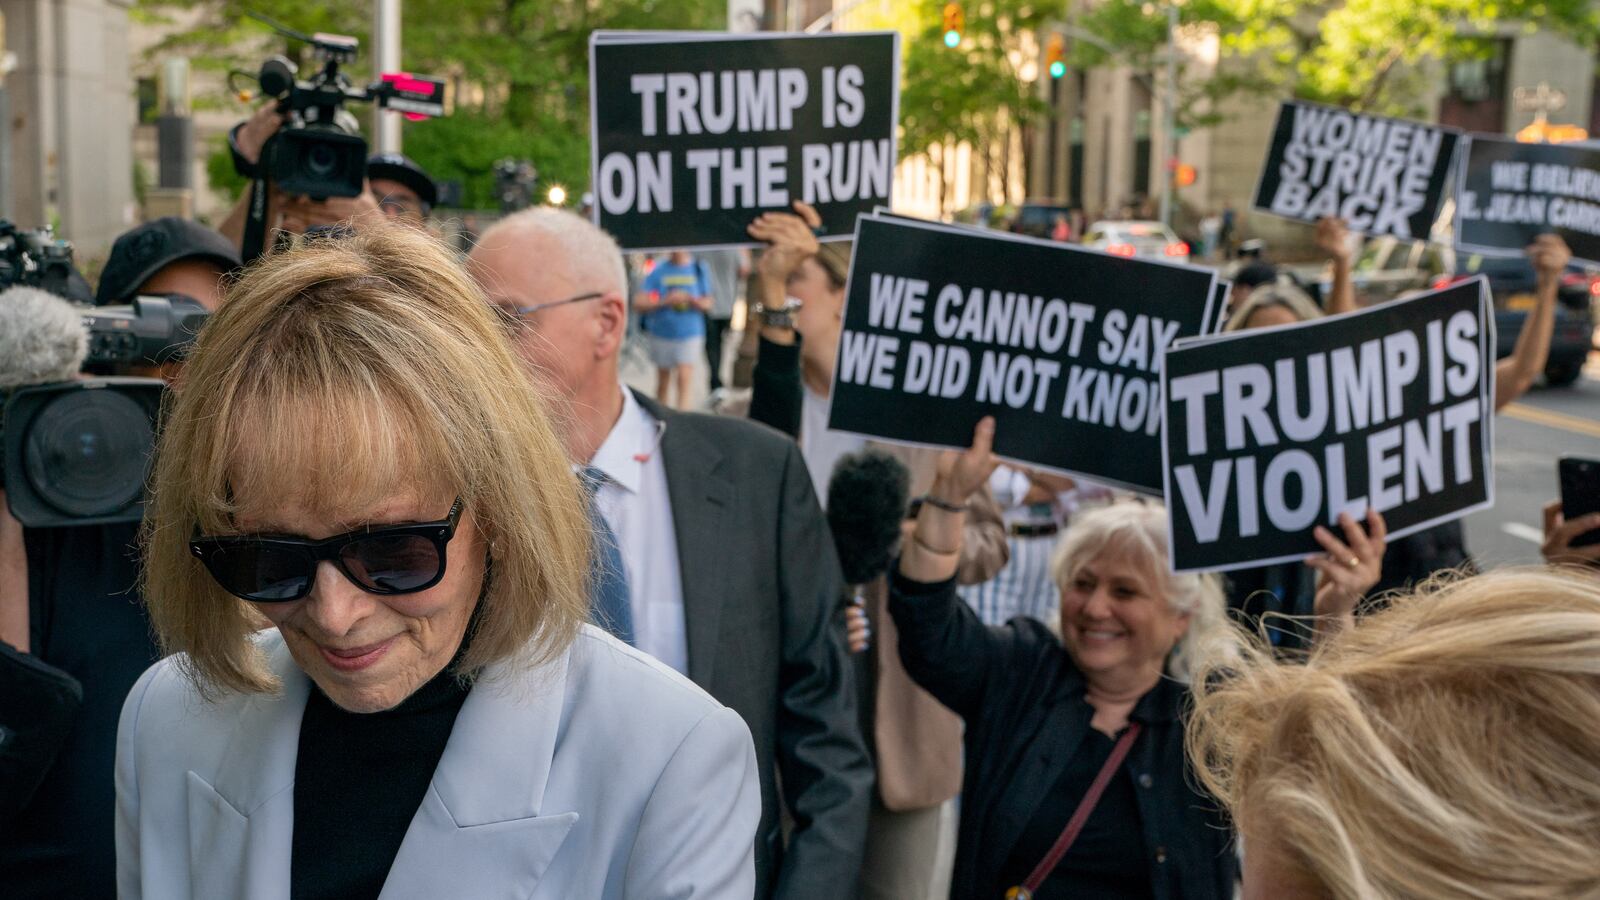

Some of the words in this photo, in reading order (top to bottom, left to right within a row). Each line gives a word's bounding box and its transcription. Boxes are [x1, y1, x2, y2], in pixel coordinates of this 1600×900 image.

[631, 67, 808, 136] TRUMP
[822, 64, 865, 128] IS
[1292, 104, 1443, 170] WOMEN
[599, 151, 673, 215] ON
[686, 146, 789, 210] THE
[802, 138, 890, 204] RUN
[1279, 141, 1431, 200] STRIKE
[1491, 161, 1529, 191] WE
[1271, 178, 1425, 240] BACK
[868, 272, 929, 334] WE
[934, 283, 1096, 358] CANNOT
[1097, 308, 1180, 374] SAY
[840, 329, 900, 390] WE
[903, 340, 971, 399] DID
[976, 350, 1061, 413] NOT
[1170, 329, 1420, 456] TRUMP
[1426, 310, 1480, 405] IS
[1173, 398, 1480, 545] VIOLENT
